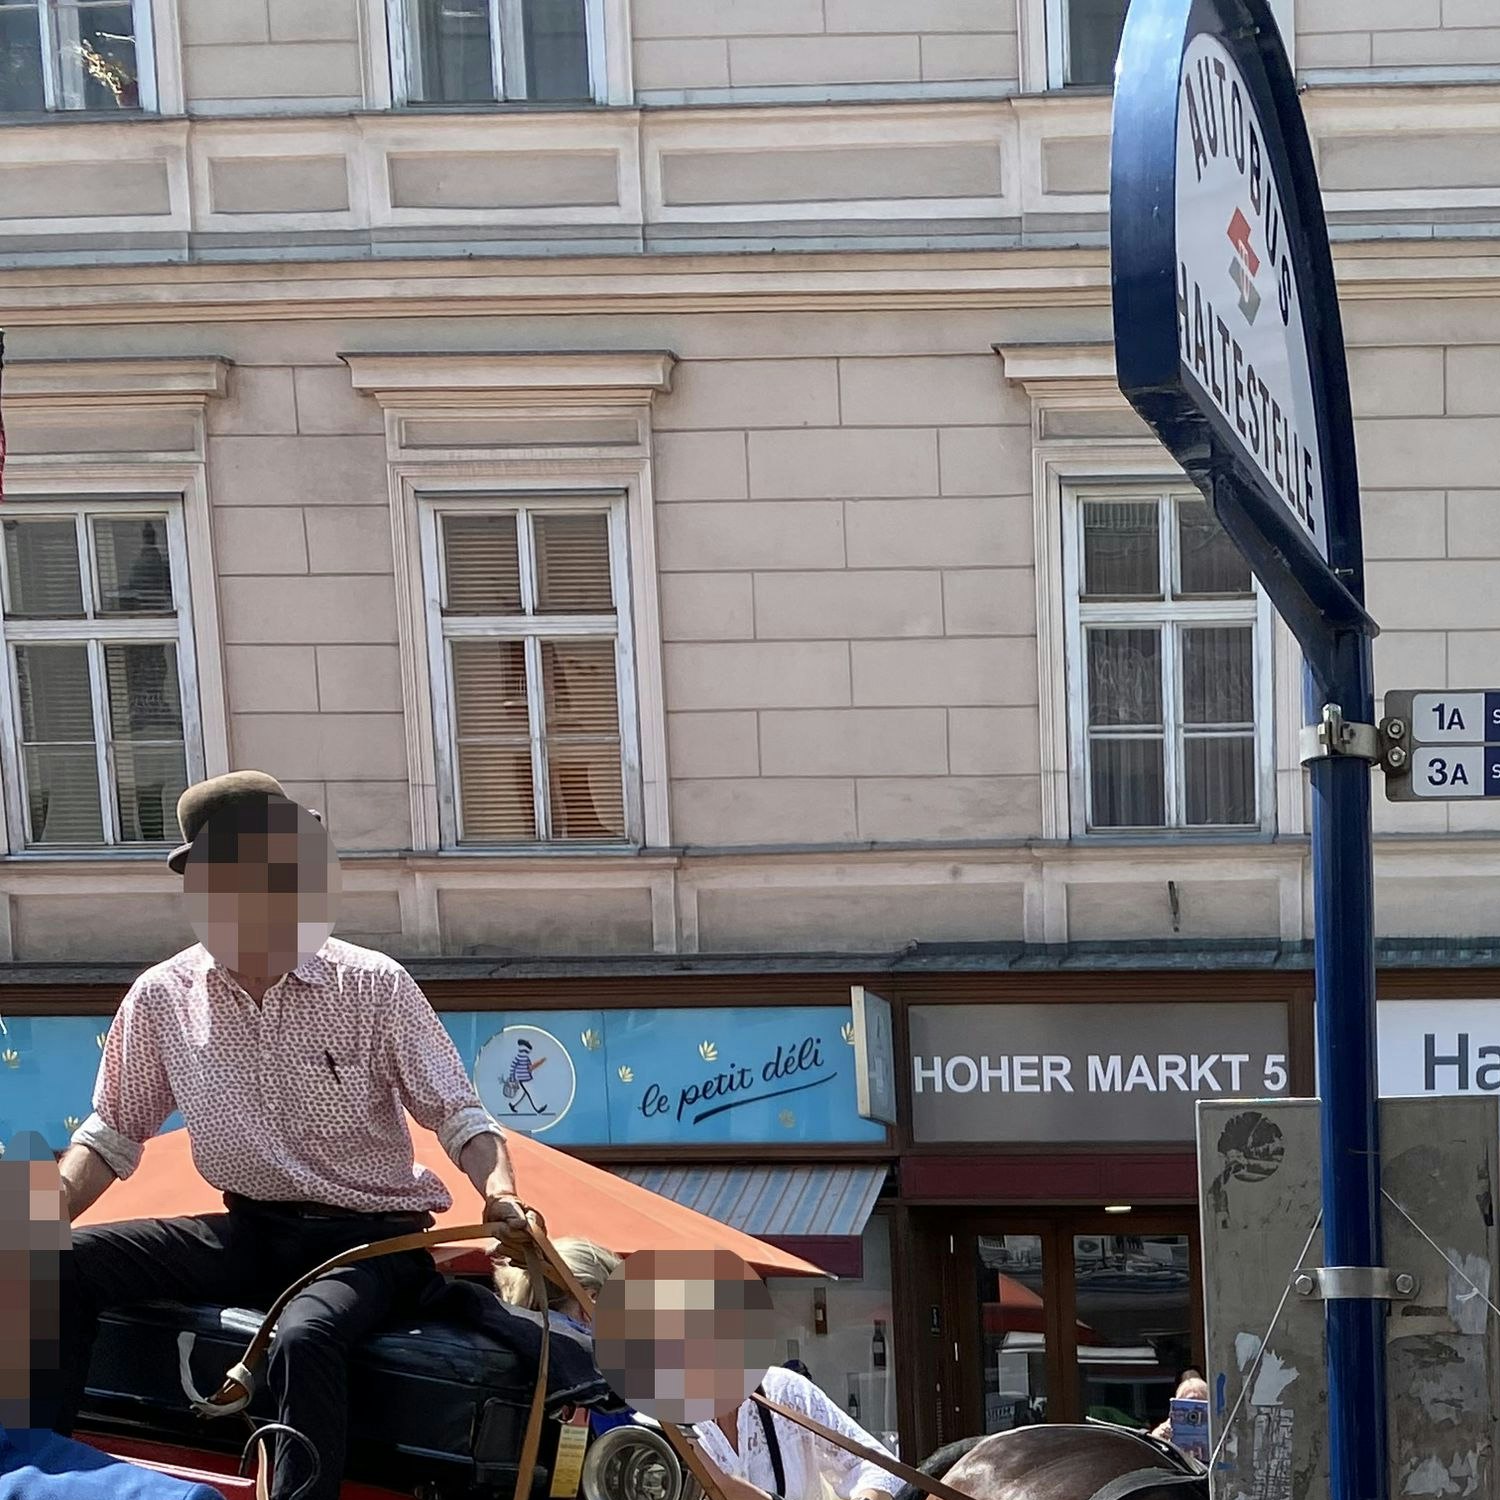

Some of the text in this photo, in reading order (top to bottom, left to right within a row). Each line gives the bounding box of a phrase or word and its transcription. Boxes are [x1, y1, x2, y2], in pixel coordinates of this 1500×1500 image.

[1185, 56, 1292, 327] AUTOBUS
[1179, 261, 1316, 535] HALTESTELLE
[1432, 702, 1466, 731] 1A
[1427, 758, 1470, 786] 3A
[638, 1036, 824, 1122] le petit déli
[913, 1054, 1287, 1093] HOHER MARKT 5
